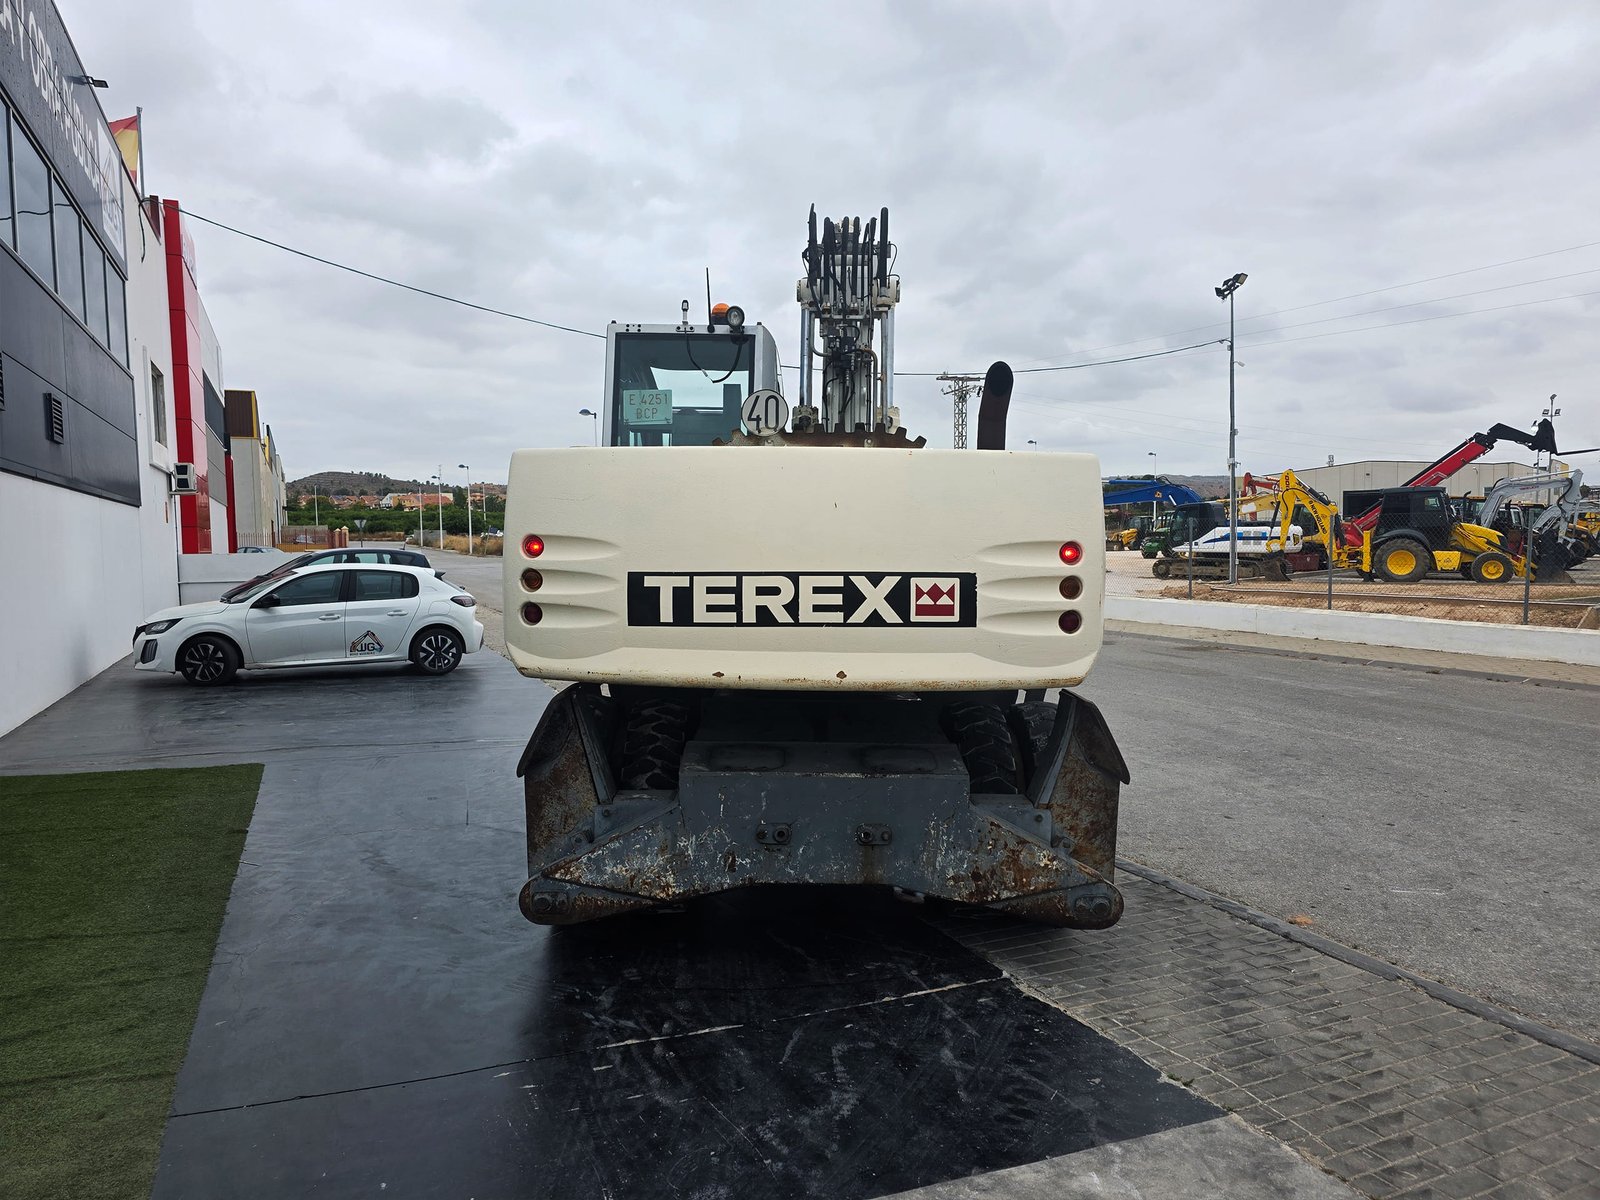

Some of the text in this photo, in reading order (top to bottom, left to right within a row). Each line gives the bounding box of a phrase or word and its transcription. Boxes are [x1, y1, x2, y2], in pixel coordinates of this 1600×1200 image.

[29, 11, 63, 131] OBRA
[629, 393, 668, 405] E 4251
[636, 407, 658, 420] BCP
[747, 395, 779, 432] 40
[1315, 513, 1327, 534] HOLLAND
[643, 575, 904, 624] TEREX
